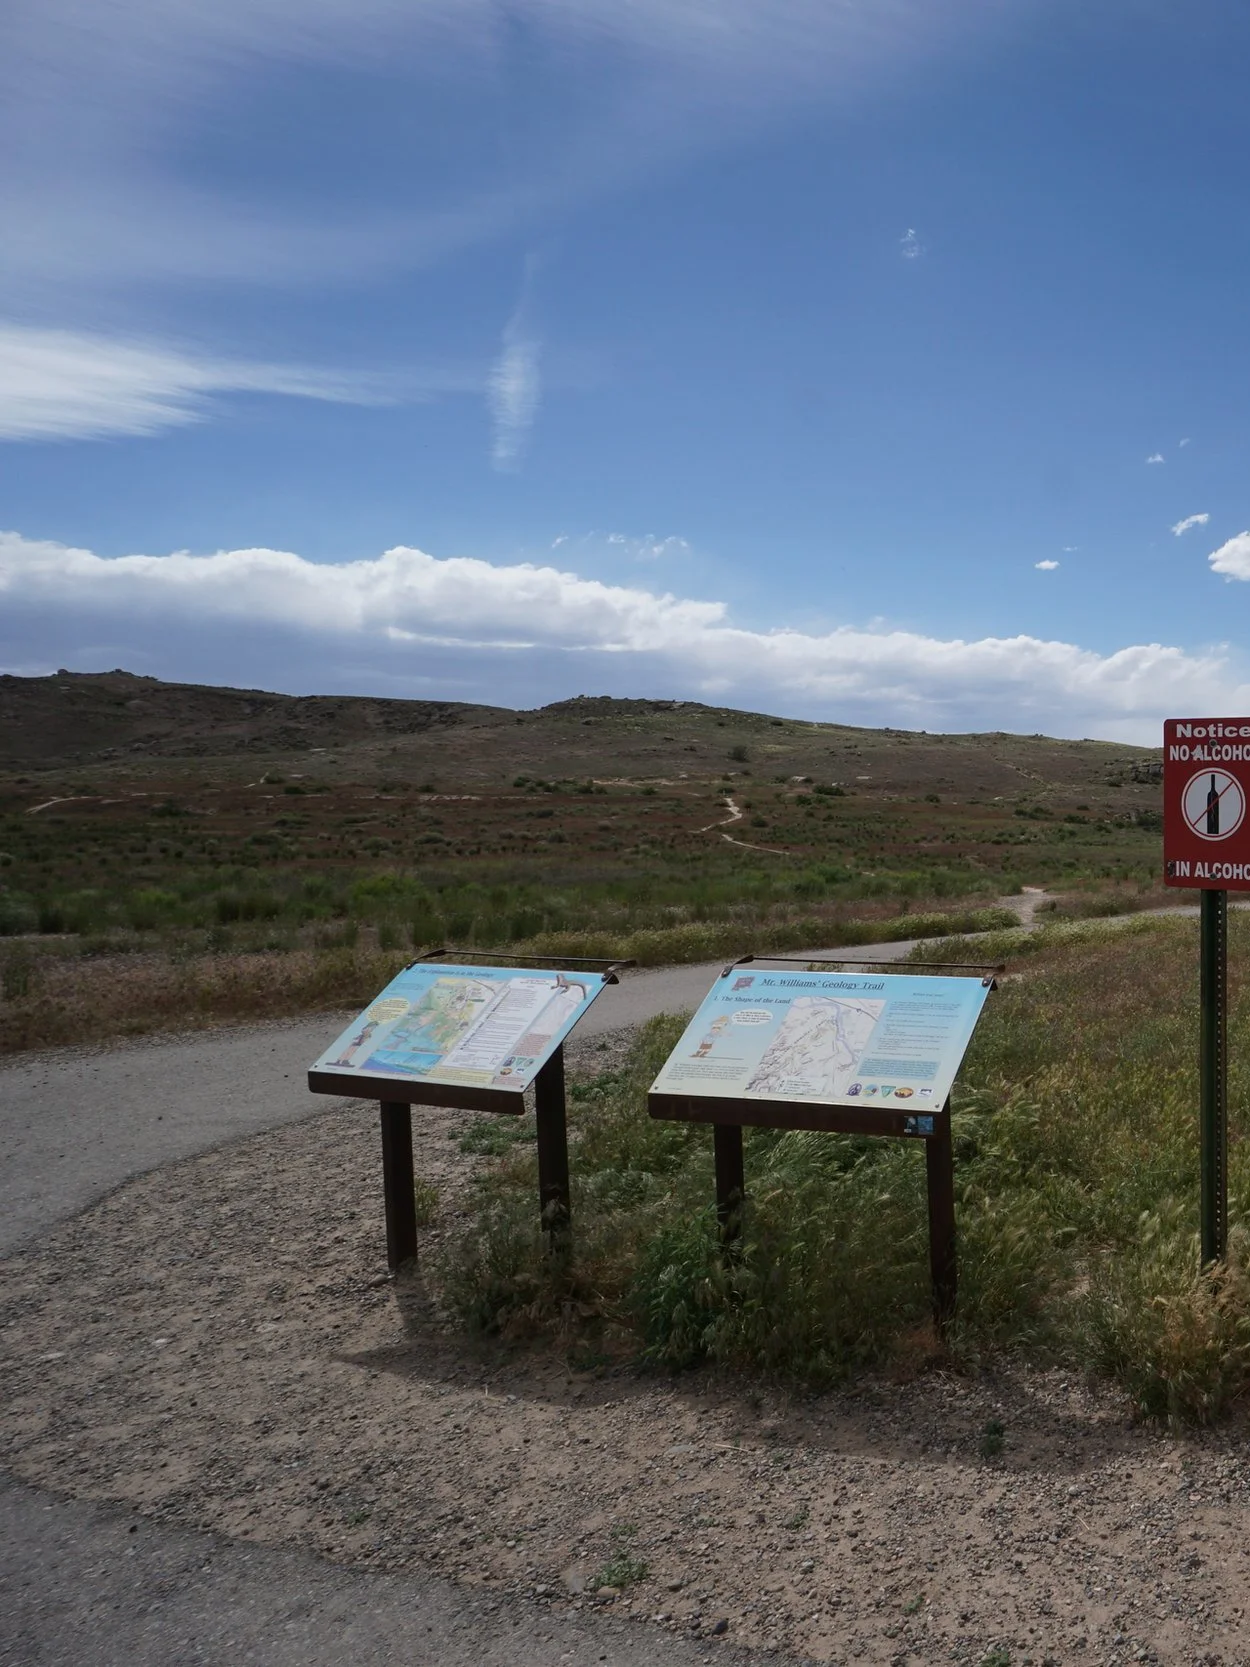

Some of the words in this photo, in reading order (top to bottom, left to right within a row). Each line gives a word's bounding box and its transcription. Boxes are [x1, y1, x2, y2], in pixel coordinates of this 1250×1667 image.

[1170, 745, 1189, 761] NO
[779, 979, 821, 988] Williams'
[822, 981, 859, 989] Geology
[863, 982, 885, 990] Trail
